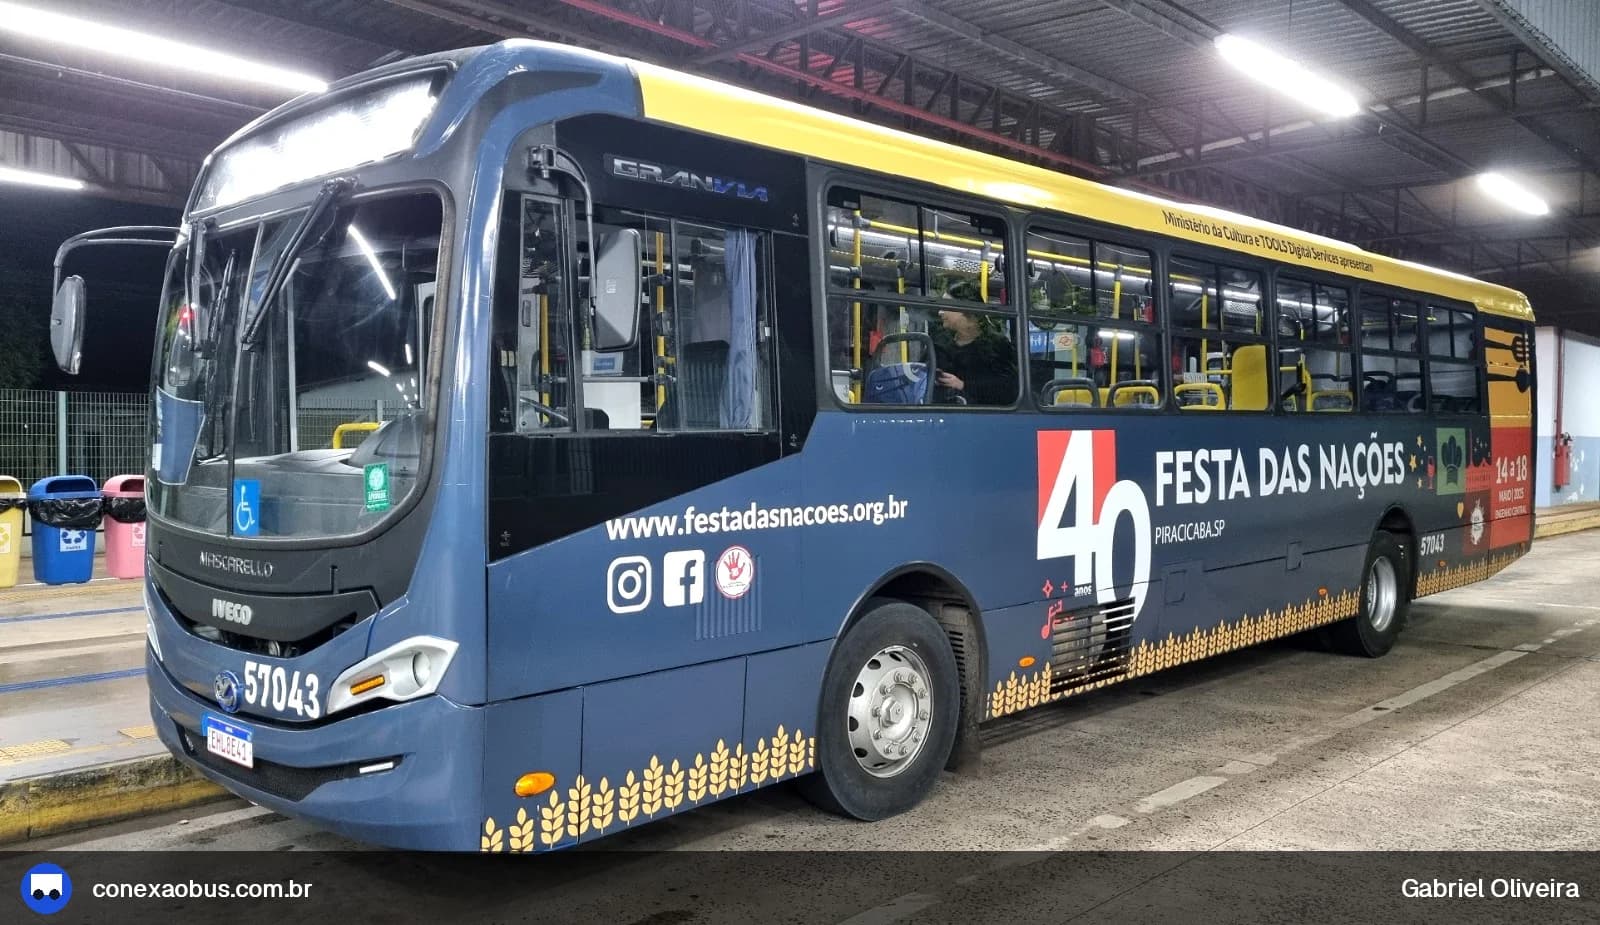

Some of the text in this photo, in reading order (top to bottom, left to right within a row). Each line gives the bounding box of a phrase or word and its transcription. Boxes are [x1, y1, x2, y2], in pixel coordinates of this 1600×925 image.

[613, 157, 768, 202] GRANVIA
[1162, 210, 1210, 235] Ministério
[1211, 225, 1223, 238] da
[1223, 225, 1254, 246] Cultura
[1260, 234, 1288, 253] TOOLS
[1288, 241, 1312, 260] Digital
[1312, 247, 1339, 265] Services
[1339, 255, 1374, 273] apresentam
[1156, 431, 1406, 507] FESTA DAS NAÇÕES
[1496, 454, 1528, 484] 14 a 18
[605, 494, 908, 541] www.festadasnacoes.org.br
[1155, 519, 1225, 545] PIRACICABA.SP
[1420, 533, 1445, 556] 57043
[199, 550, 273, 578] MASCARELLO
[1074, 585, 1092, 597] anos
[212, 598, 253, 626] IVECO
[244, 660, 320, 719] 57043
[211, 730, 247, 761] EHL8E41
